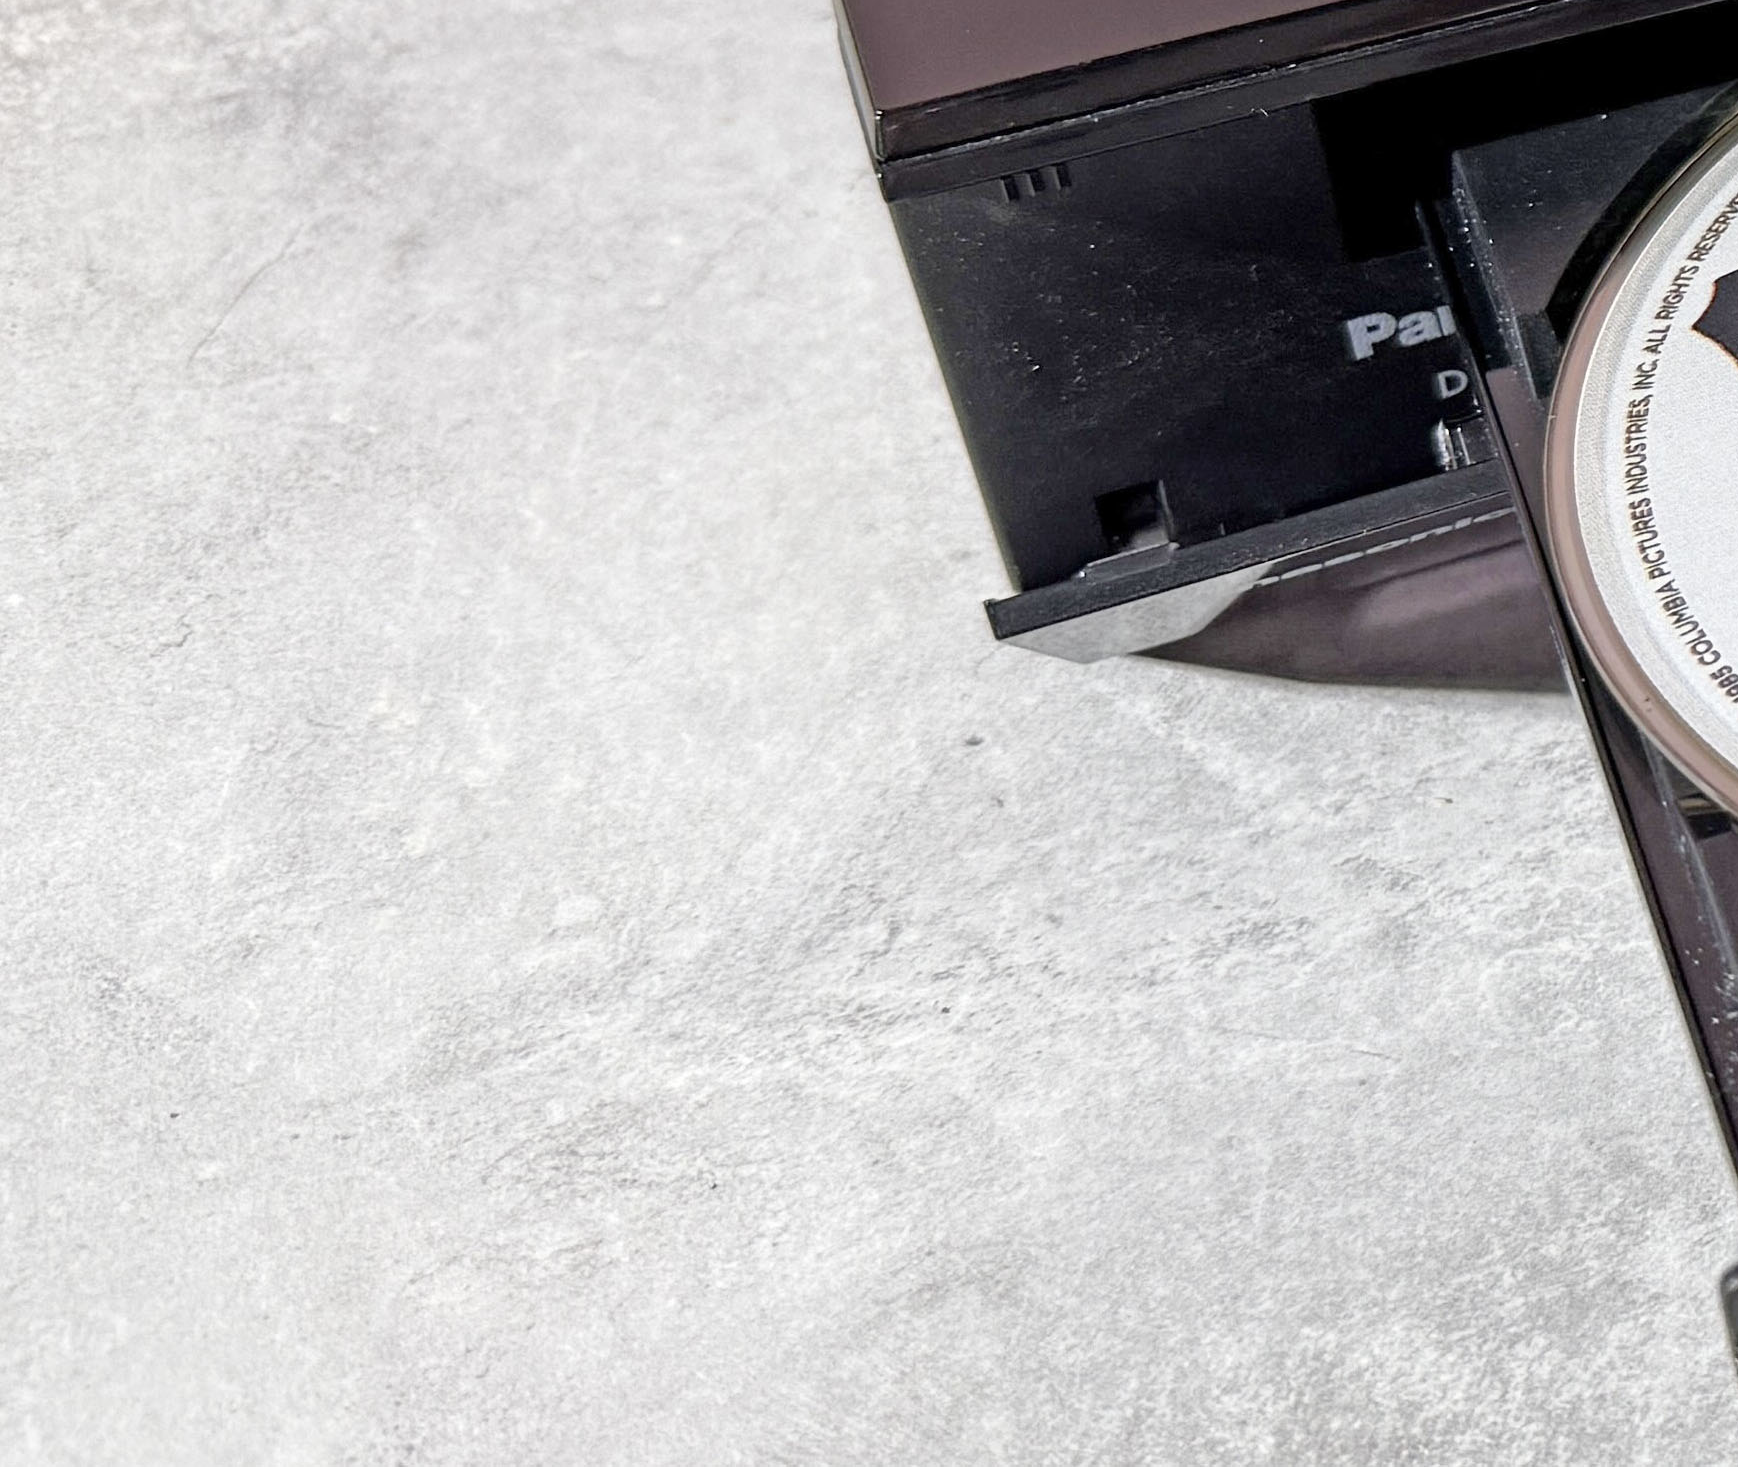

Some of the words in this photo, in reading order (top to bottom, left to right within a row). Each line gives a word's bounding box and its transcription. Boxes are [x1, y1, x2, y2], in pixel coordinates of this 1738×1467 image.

[1654, 264, 1700, 321] RIGHTS
[1642, 322, 1671, 355] ALL
[1623, 392, 1654, 494] INDUSTRIES,
[1627, 497, 1672, 581] PICTURES
[1654, 578, 1722, 666] COLUMBIA
